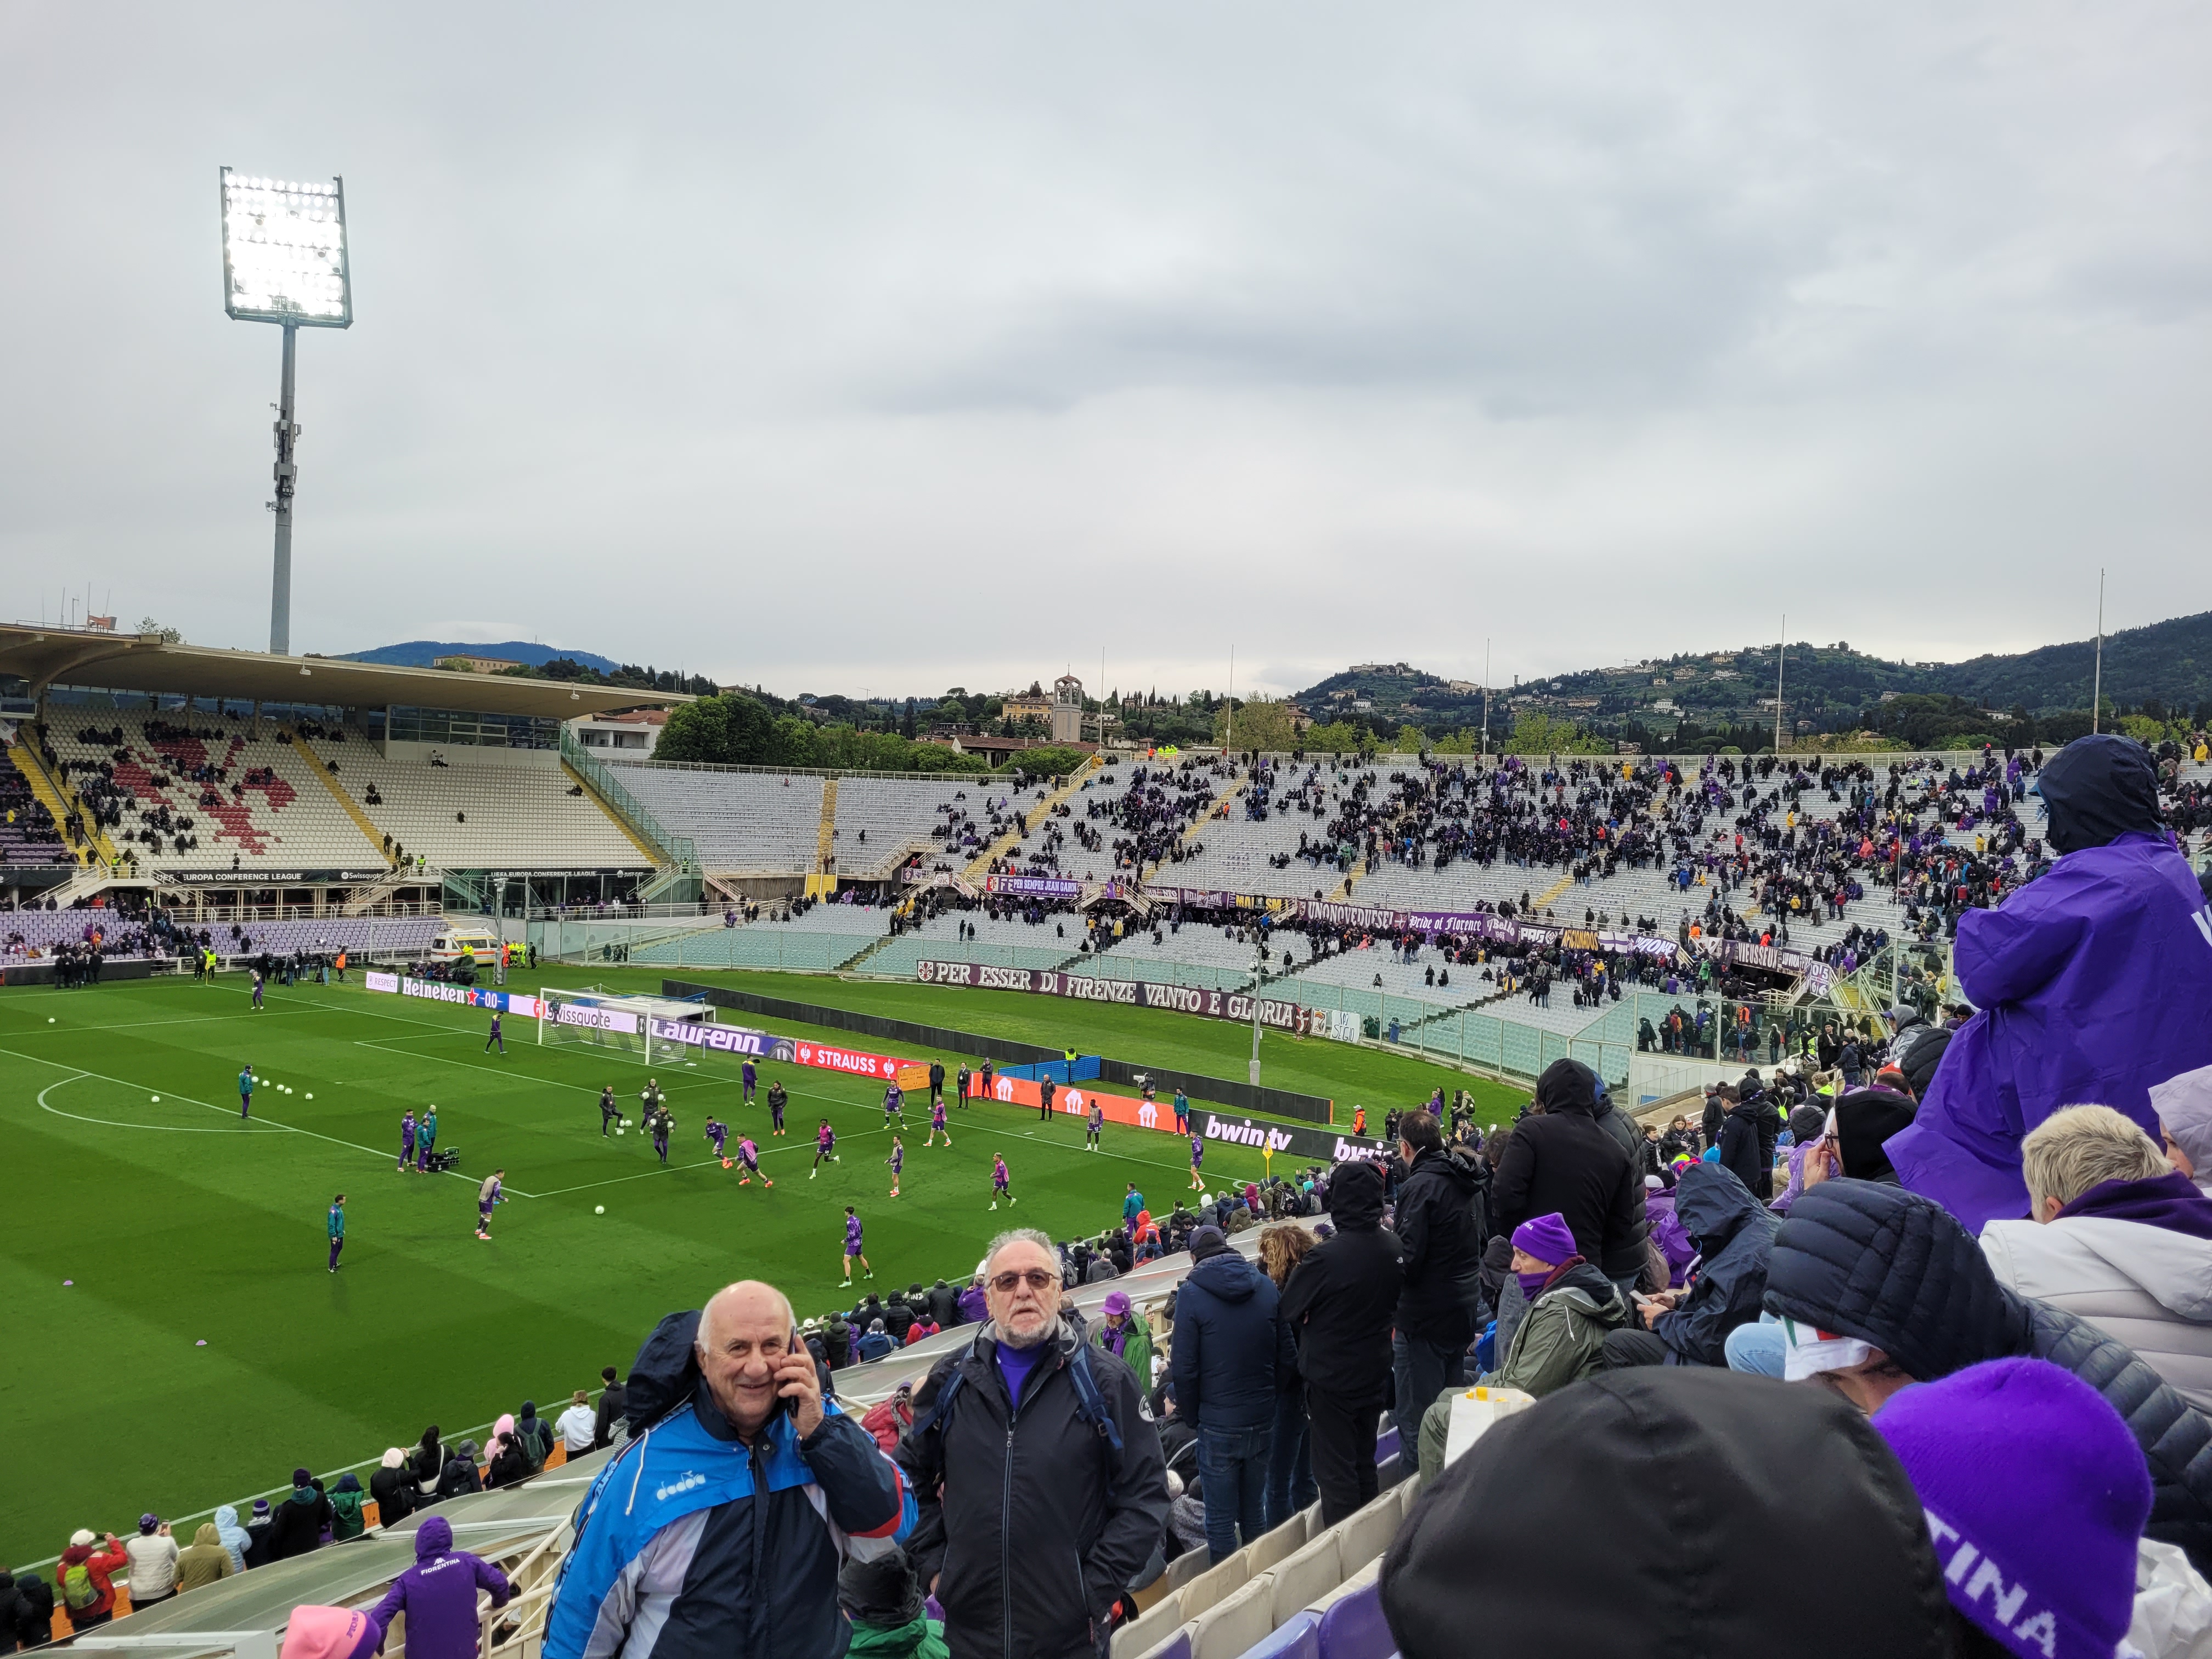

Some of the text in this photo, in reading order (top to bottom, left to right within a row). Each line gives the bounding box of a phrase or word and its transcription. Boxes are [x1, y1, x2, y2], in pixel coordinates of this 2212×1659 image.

[1013, 879, 1024, 889] PER
[1024, 880, 1045, 890] SEMPRE
[1045, 881, 1059, 891] JEAN
[1208, 891, 1222, 905] EMPRE
[1236, 895, 1255, 910] MAI
[1409, 915, 1482, 932] Pride of Florence
[1495, 930, 1505, 939] 1965
[1561, 929, 1599, 951] AFICIONADOS
[1738, 942, 1779, 969] VIEUSSEUX
[374, 977, 397, 988] RESPECT
[402, 977, 465, 1004] Heineken
[935, 962, 1294, 1027] PER ESSER DI FIRENZE VANTO E GLORIA
[548, 1003, 611, 1028] Sissquote
[817, 1049, 876, 1074] STRAUSS
[657, 1470, 706, 1500] diadora
[420, 1558, 460, 1576] FIORENTINA
